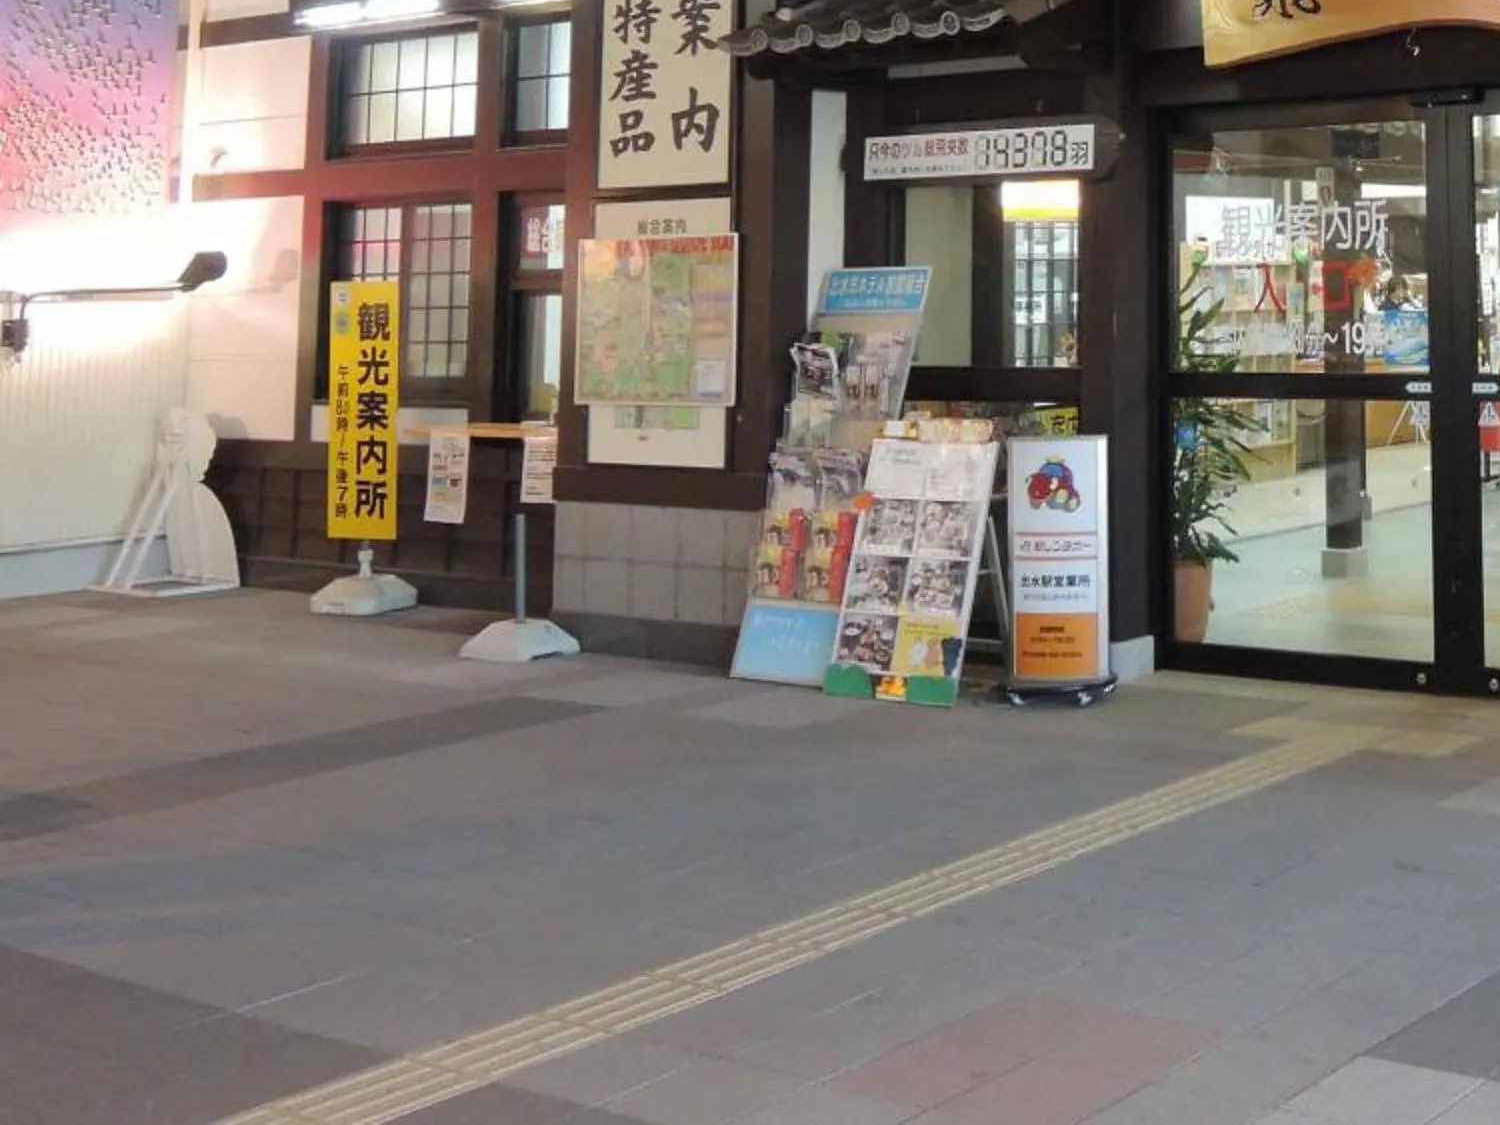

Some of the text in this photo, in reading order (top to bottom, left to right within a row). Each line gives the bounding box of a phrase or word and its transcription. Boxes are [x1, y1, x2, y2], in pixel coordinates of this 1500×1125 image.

[1221, 200, 1389, 254] 観光案内所
[353, 302, 391, 520] 観光案内所
